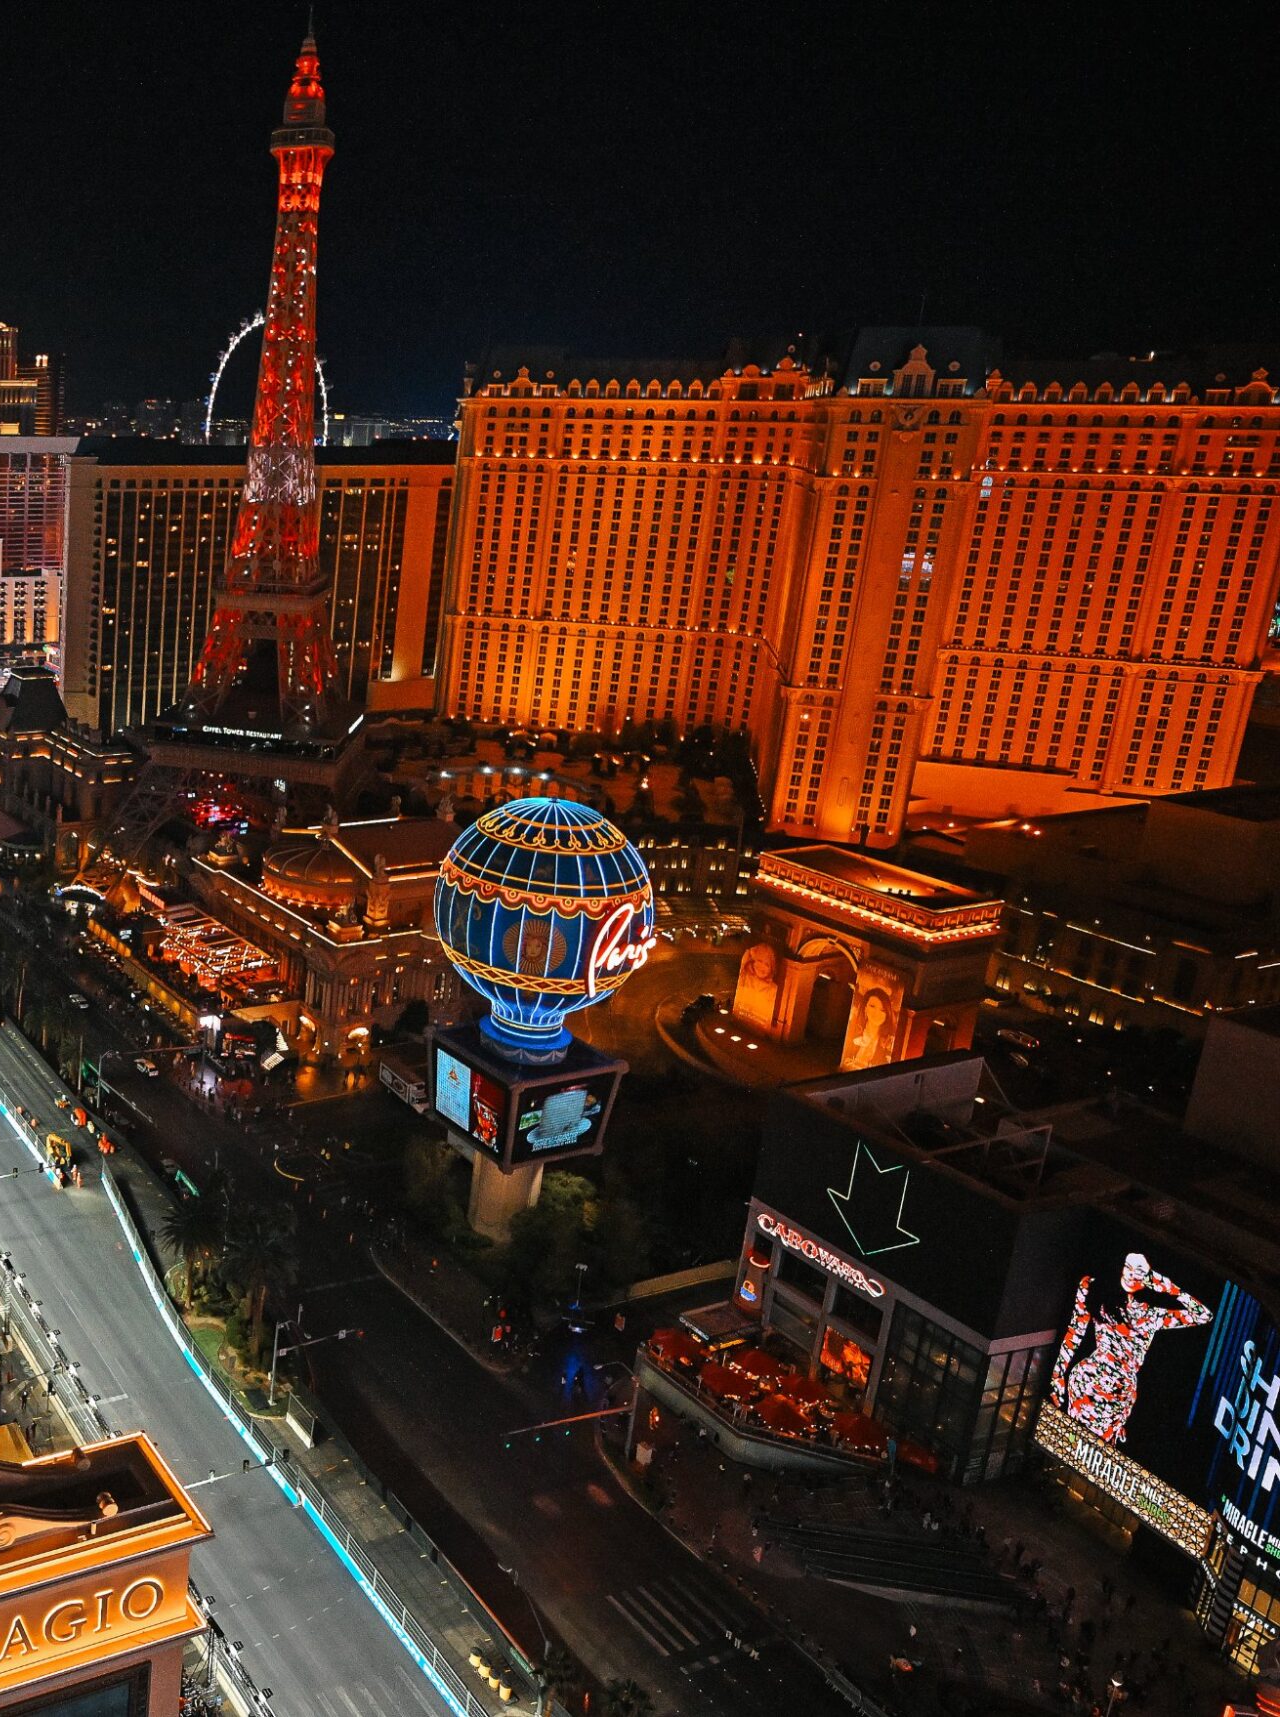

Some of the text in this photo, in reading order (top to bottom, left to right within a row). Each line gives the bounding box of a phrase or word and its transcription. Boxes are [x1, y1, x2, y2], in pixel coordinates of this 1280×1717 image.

[202, 725, 223, 735] EIFFEL
[223, 727, 245, 737] TOWER
[588, 902, 657, 999] Paris
[757, 1213, 819, 1259] CABO
[1074, 1438, 1165, 1507] MIRACLE MILE
[1138, 1495, 1169, 1525] SHOPS
[1222, 1498, 1269, 1550] MIRACLE
